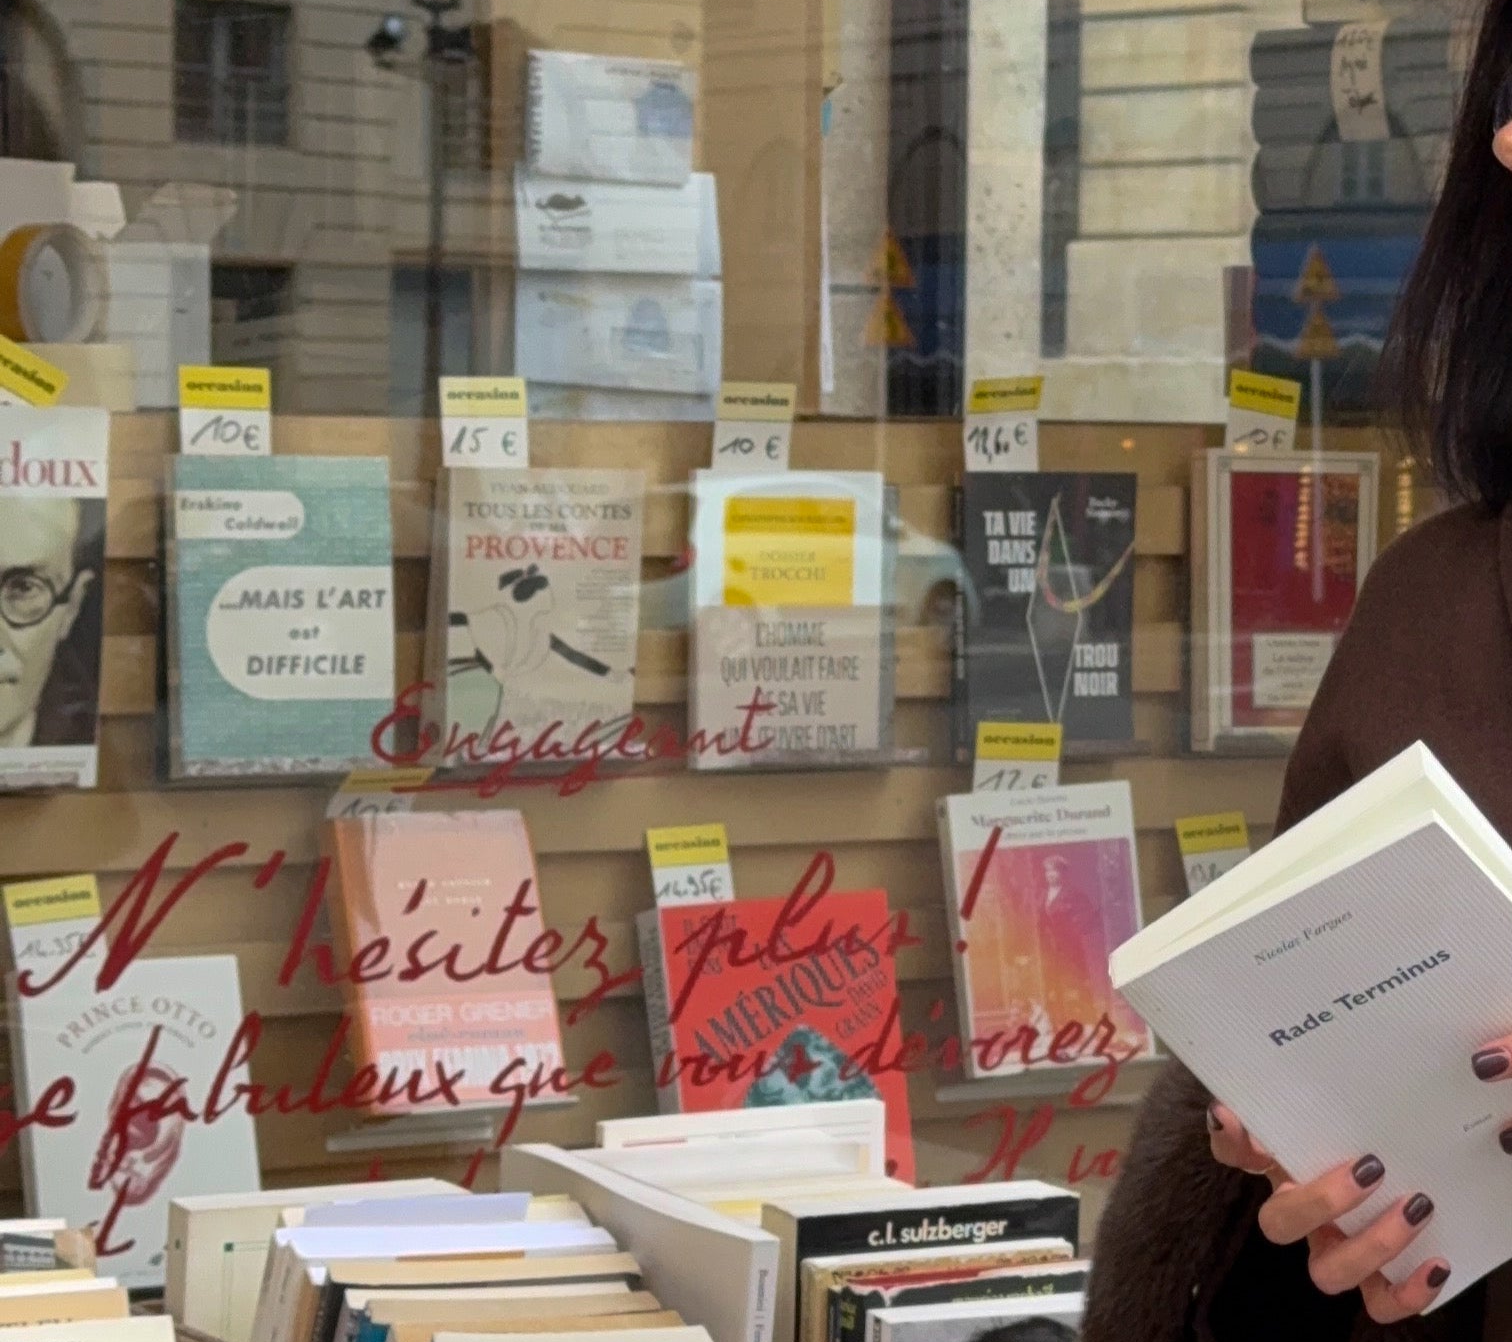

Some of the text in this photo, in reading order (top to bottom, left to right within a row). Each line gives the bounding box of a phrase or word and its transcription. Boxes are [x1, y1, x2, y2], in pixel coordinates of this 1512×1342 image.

[185, 377, 263, 395] occasion
[447, 387, 520, 404] occasion
[724, 393, 790, 410] occasion
[190, 415, 261, 452] 10€
[464, 502, 633, 520] TOUS LES CONTES
[982, 510, 1037, 537] TA VIE
[465, 535, 628, 561] PROVENCE
[986, 538, 1037, 565] DANS
[1007, 567, 1037, 593] UN
[316, 586, 387, 610] L'ART
[288, 625, 321, 641] est
[246, 654, 366, 676] DIFFICILE
[1073, 643, 1120, 669] TROU
[1072, 671, 1120, 697] NOIR
[984, 734, 1057, 747] occasion
[1253, 937, 1301, 966] Nicolas
[1268, 948, 1452, 1047] Rade Terminus
[56, 994, 141, 1049] PRINCE
[151, 996, 218, 1040] OTTO
[489, 1045, 623, 1147] que
[868, 1217, 1009, 1247] c.l. sulzberger
